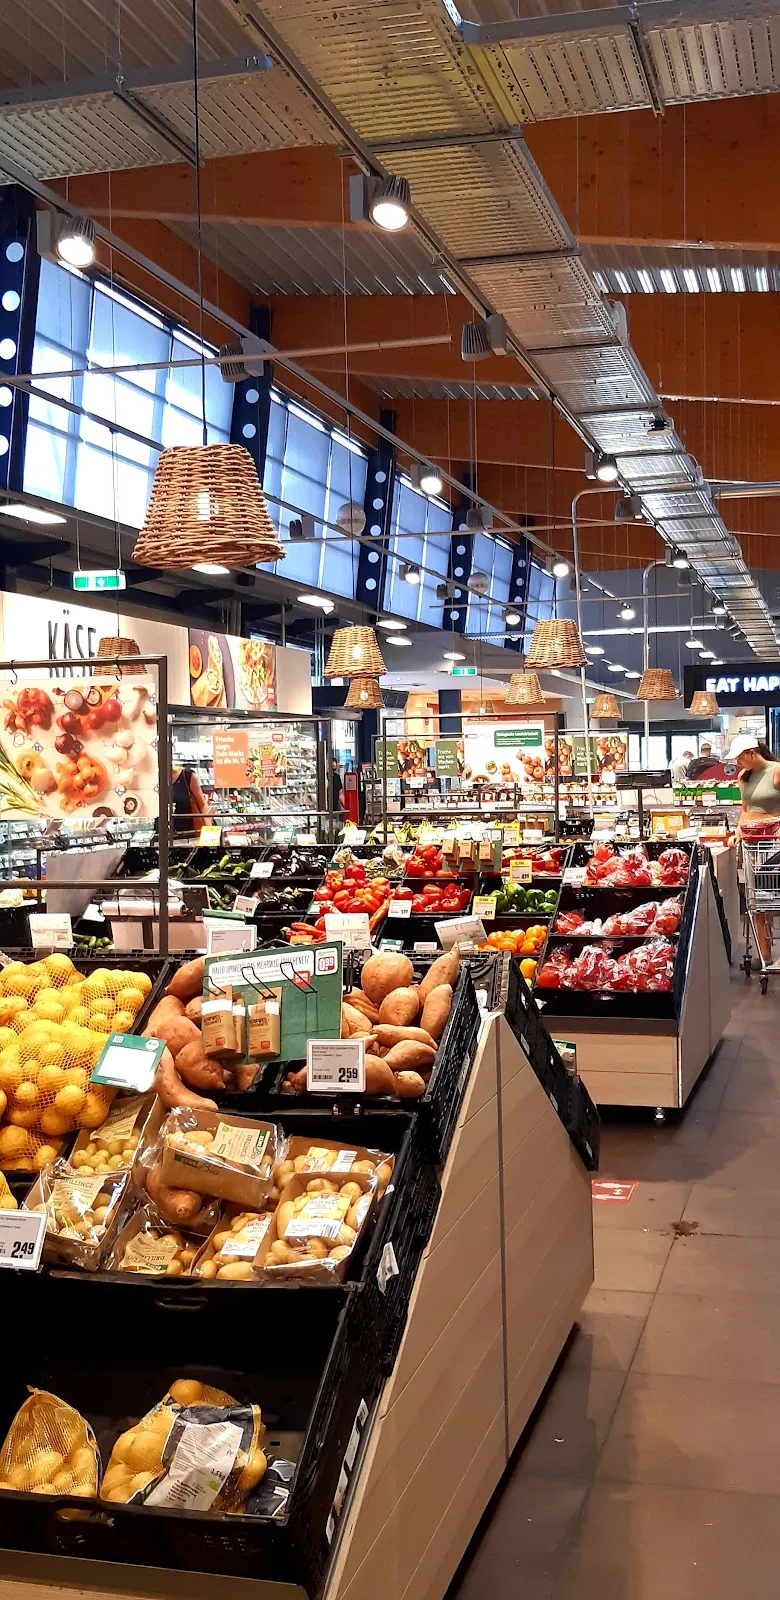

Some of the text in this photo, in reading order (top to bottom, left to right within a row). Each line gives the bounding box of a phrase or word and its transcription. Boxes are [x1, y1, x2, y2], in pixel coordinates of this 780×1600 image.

[706, 676, 780, 693] EAT HAP
[211, 963, 226, 976] HALLO
[256, 956, 279, 971] MEHRWEG
[318, 956, 335, 972] 0.99
[112, 1035, 124, 1044] BIO
[338, 1067, 358, 1083] 2.59
[60, 1178, 95, 1189] DRILLINGE
[10, 1240, 36, 1259] 2.49
